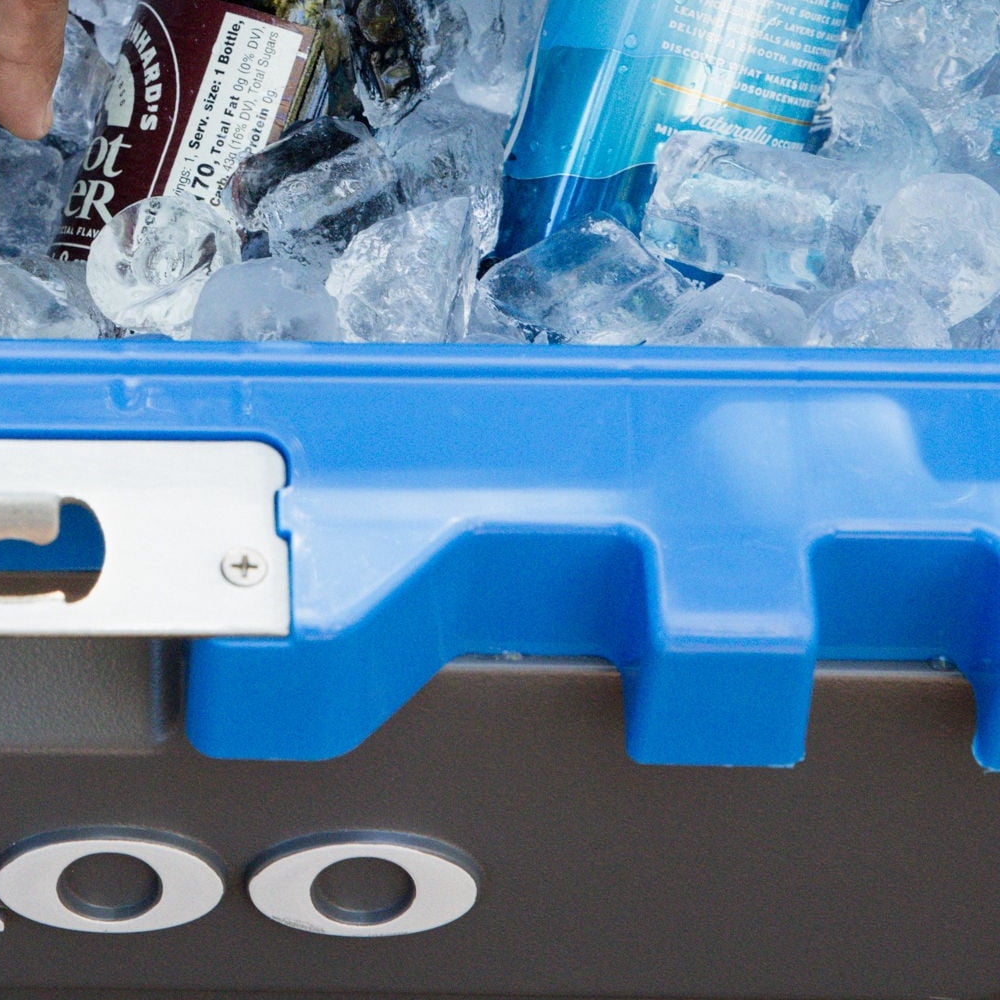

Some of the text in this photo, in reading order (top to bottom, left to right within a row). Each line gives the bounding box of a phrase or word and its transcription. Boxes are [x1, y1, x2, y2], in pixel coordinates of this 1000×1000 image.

[776, 2, 830, 26] THE SOURCE
[784, 22, 815, 38] LAYERS
[661, 40, 798, 89] DISCOVER MAKES
[783, 38, 802, 50] AND
[189, 20, 245, 150] Serv. size: Bottle,
[229, 31, 279, 150] (16% Total Sugars
[210, 77, 248, 155] Total Fat 0g
[245, 107, 270, 155] Protein
[681, 112, 773, 146] Naturally
